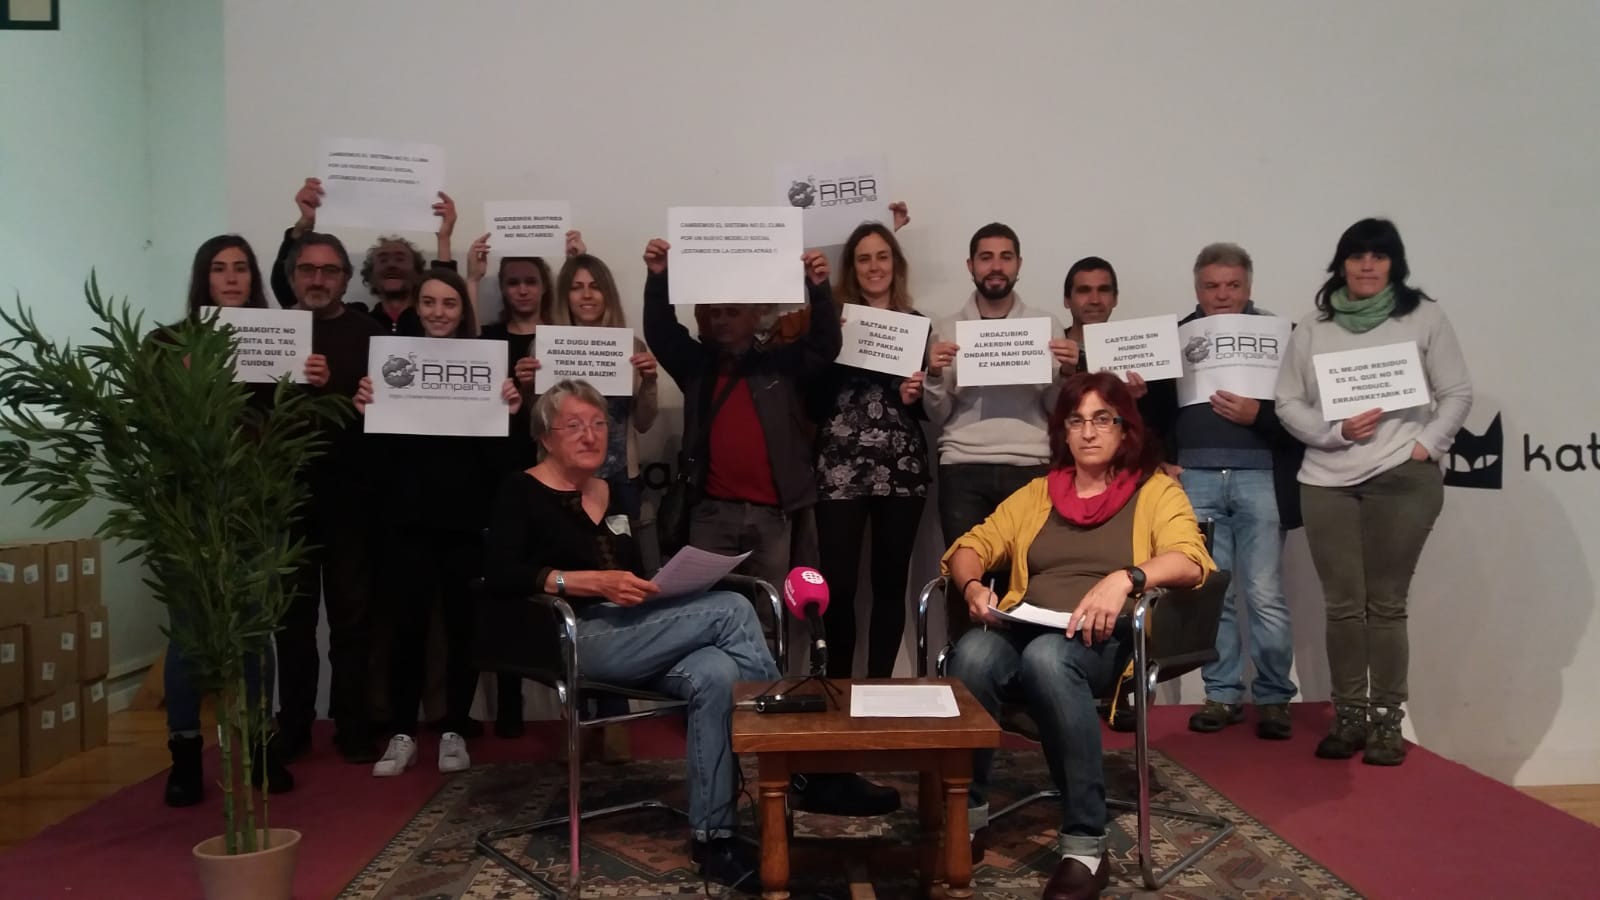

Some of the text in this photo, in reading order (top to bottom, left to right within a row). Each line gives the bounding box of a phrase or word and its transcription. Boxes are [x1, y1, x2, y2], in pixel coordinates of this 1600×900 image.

[820, 179, 876, 200] RRR
[859, 320, 888, 330] BAZTAN
[283, 327, 296, 335] NO
[979, 330, 1029, 338] URDAZUBIKO
[278, 338, 296, 346] TAV,
[858, 339, 904, 352] UTZI PAKEAN
[1215, 336, 1279, 354] RRR
[964, 351, 1000, 359] ONDAREA
[1113, 352, 1155, 361] AUTOPISTA
[241, 359, 274, 367] CUIDEN
[1340, 364, 1369, 373] MEJOR
[1370, 359, 1408, 370] RESIDUO
[421, 364, 492, 383] RRR
[1360, 373, 1378, 381] QUE
[1332, 390, 1401, 404] ERRAUSKETARIK
